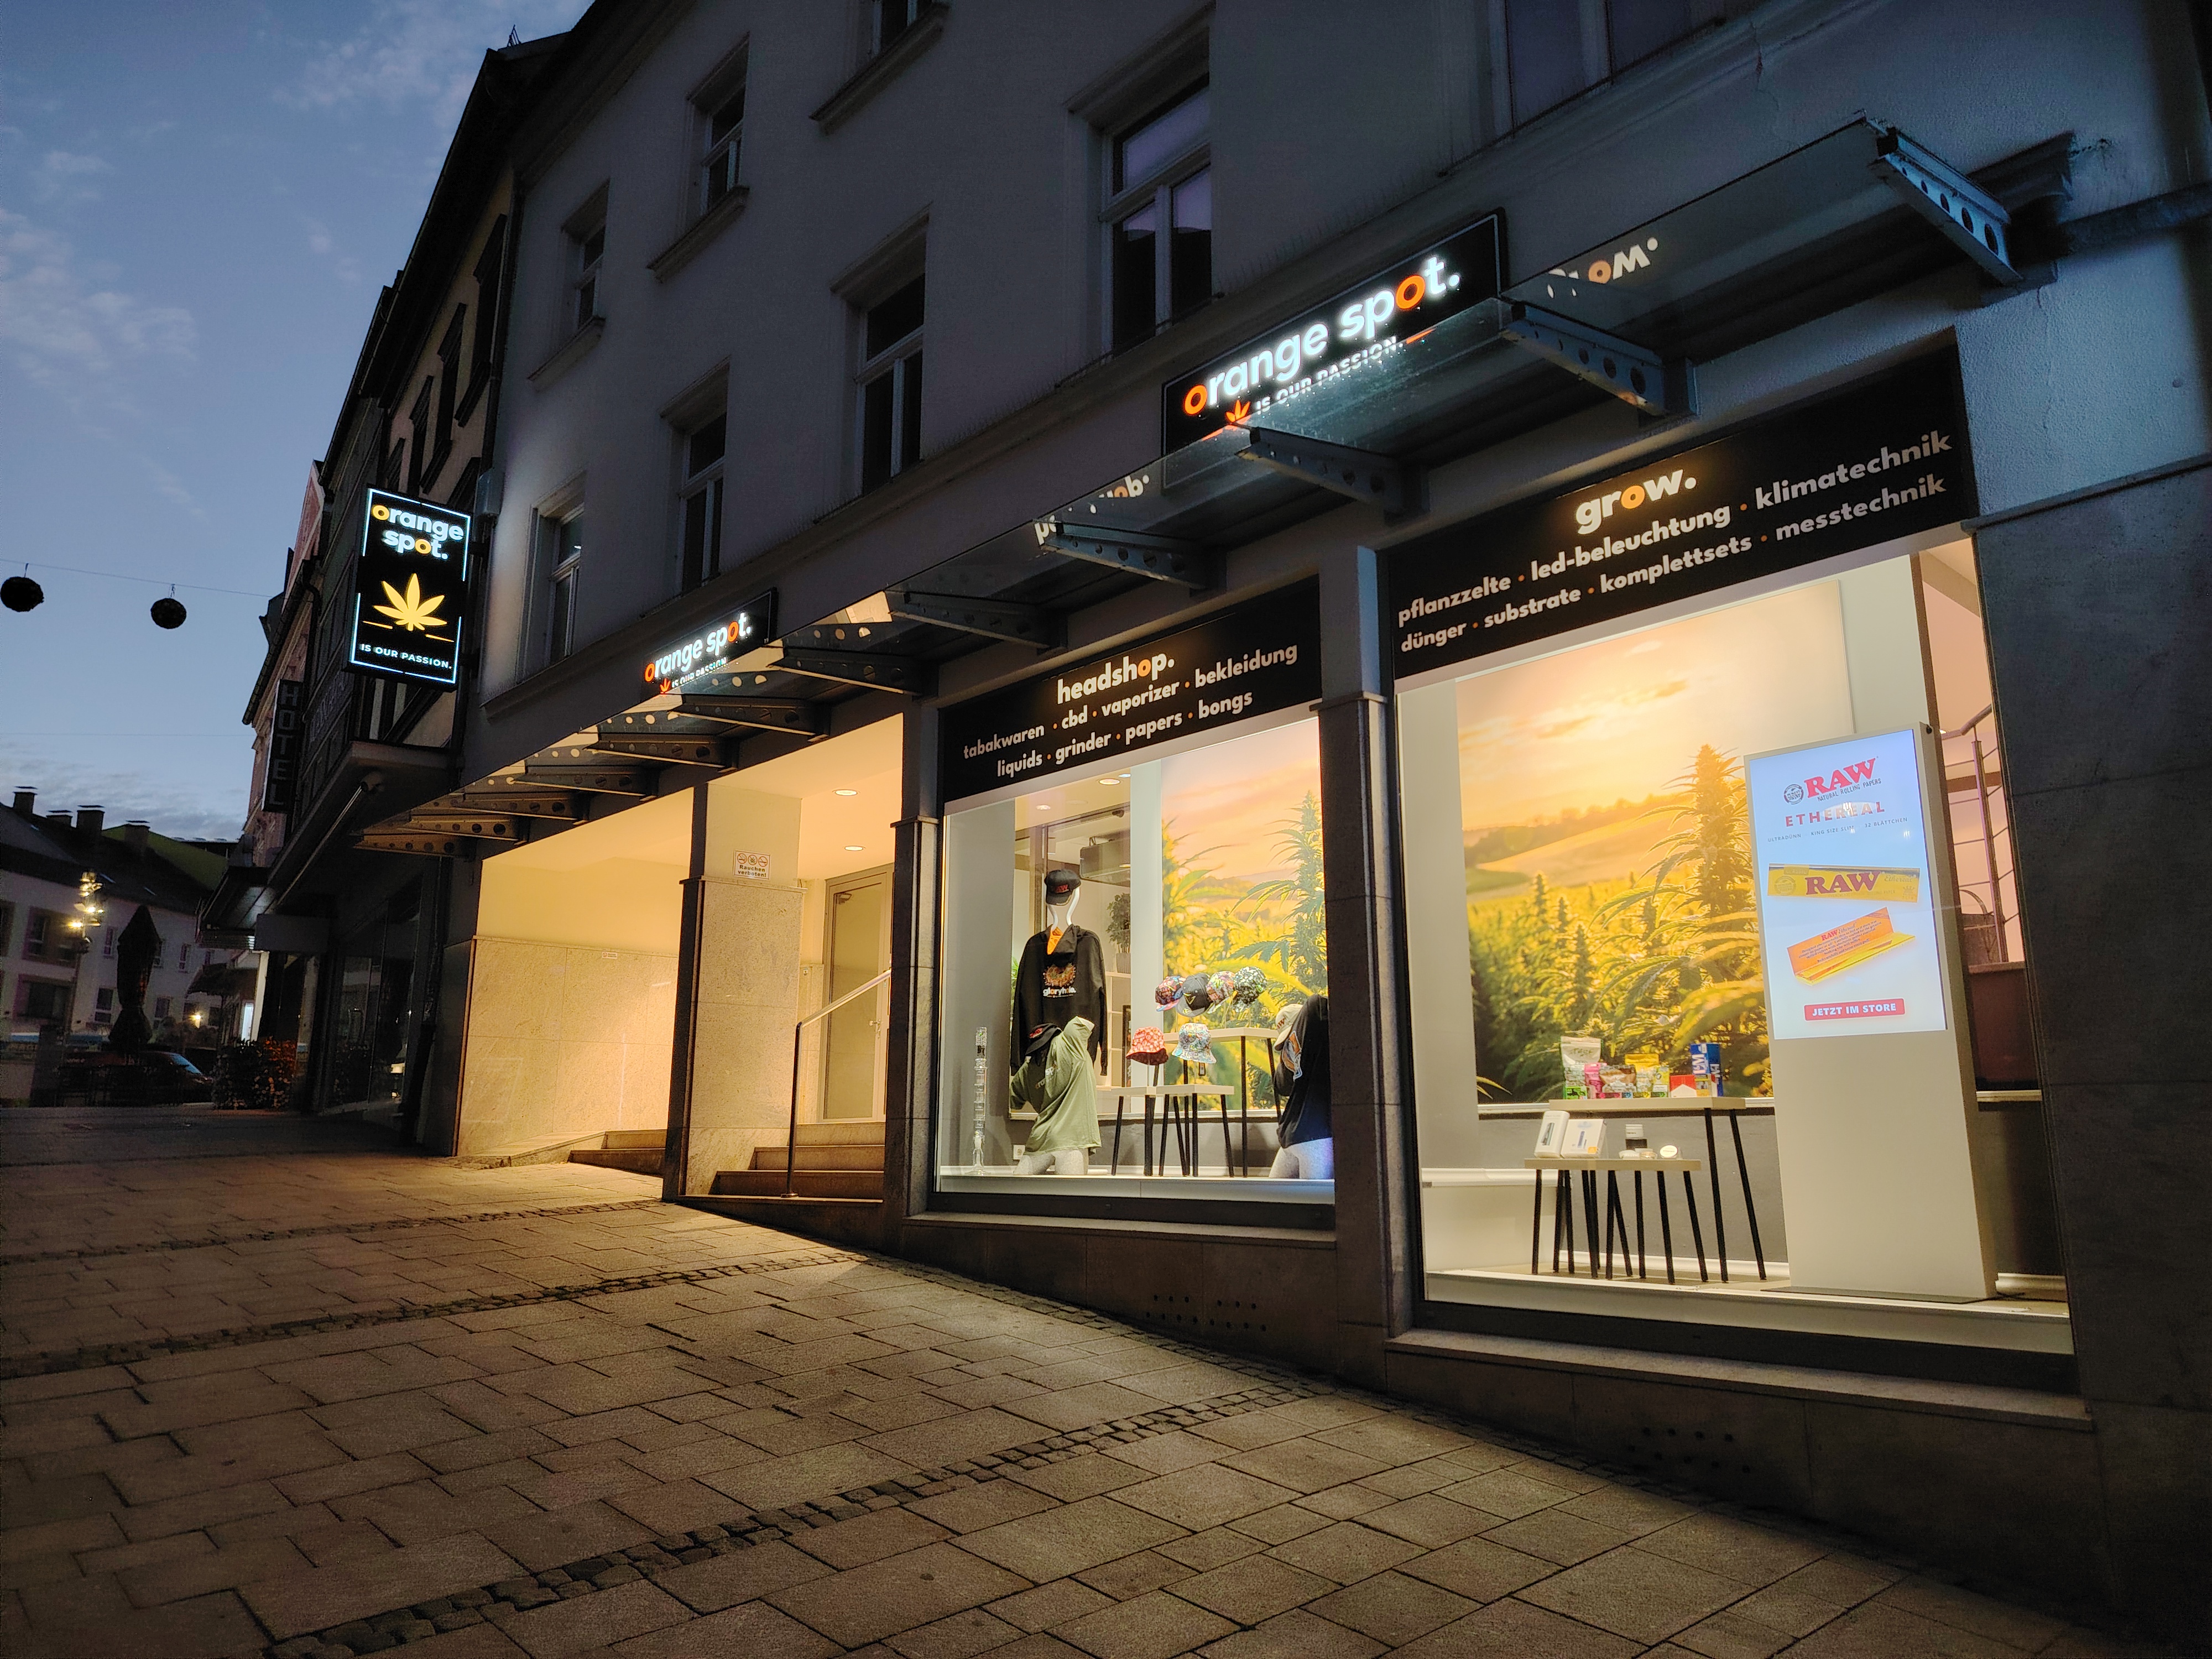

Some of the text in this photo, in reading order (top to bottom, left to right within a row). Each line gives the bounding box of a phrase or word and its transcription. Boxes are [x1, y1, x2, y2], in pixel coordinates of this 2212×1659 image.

[1185, 257, 1460, 415] orange spot.
[1575, 469, 1697, 535] grow.
[372, 504, 464, 541] orange
[1398, 430, 1953, 628] pflanzzelte led-beleuchtung klimatechnik
[383, 529, 448, 560] spot.
[1401, 473, 1947, 653] dünger substrate komplettsets messtechnik
[361, 644, 452, 669] IS OUR PASSION.
[644, 612, 752, 682] orange spot.
[1057, 651, 1175, 705] headshop.
[964, 644, 1298, 759] tabakwaren cbd vaporizer bekleidung
[269, 685, 299, 805] HOTEL
[998, 690, 1253, 778] liquids grinder papers bongs
[1804, 758, 1876, 798] RAW
[1818, 779, 1881, 801] NATURAL ROLLING PAPERS
[1786, 802, 1885, 827] ETHEREAL
[1768, 833, 1801, 842] ULTRADÜNN
[1805, 870, 1881, 895] RAW
[1822, 930, 1838, 941] RAW
[1813, 1007, 1842, 1016] JETZT
[1863, 1003, 1896, 1013] STORE
